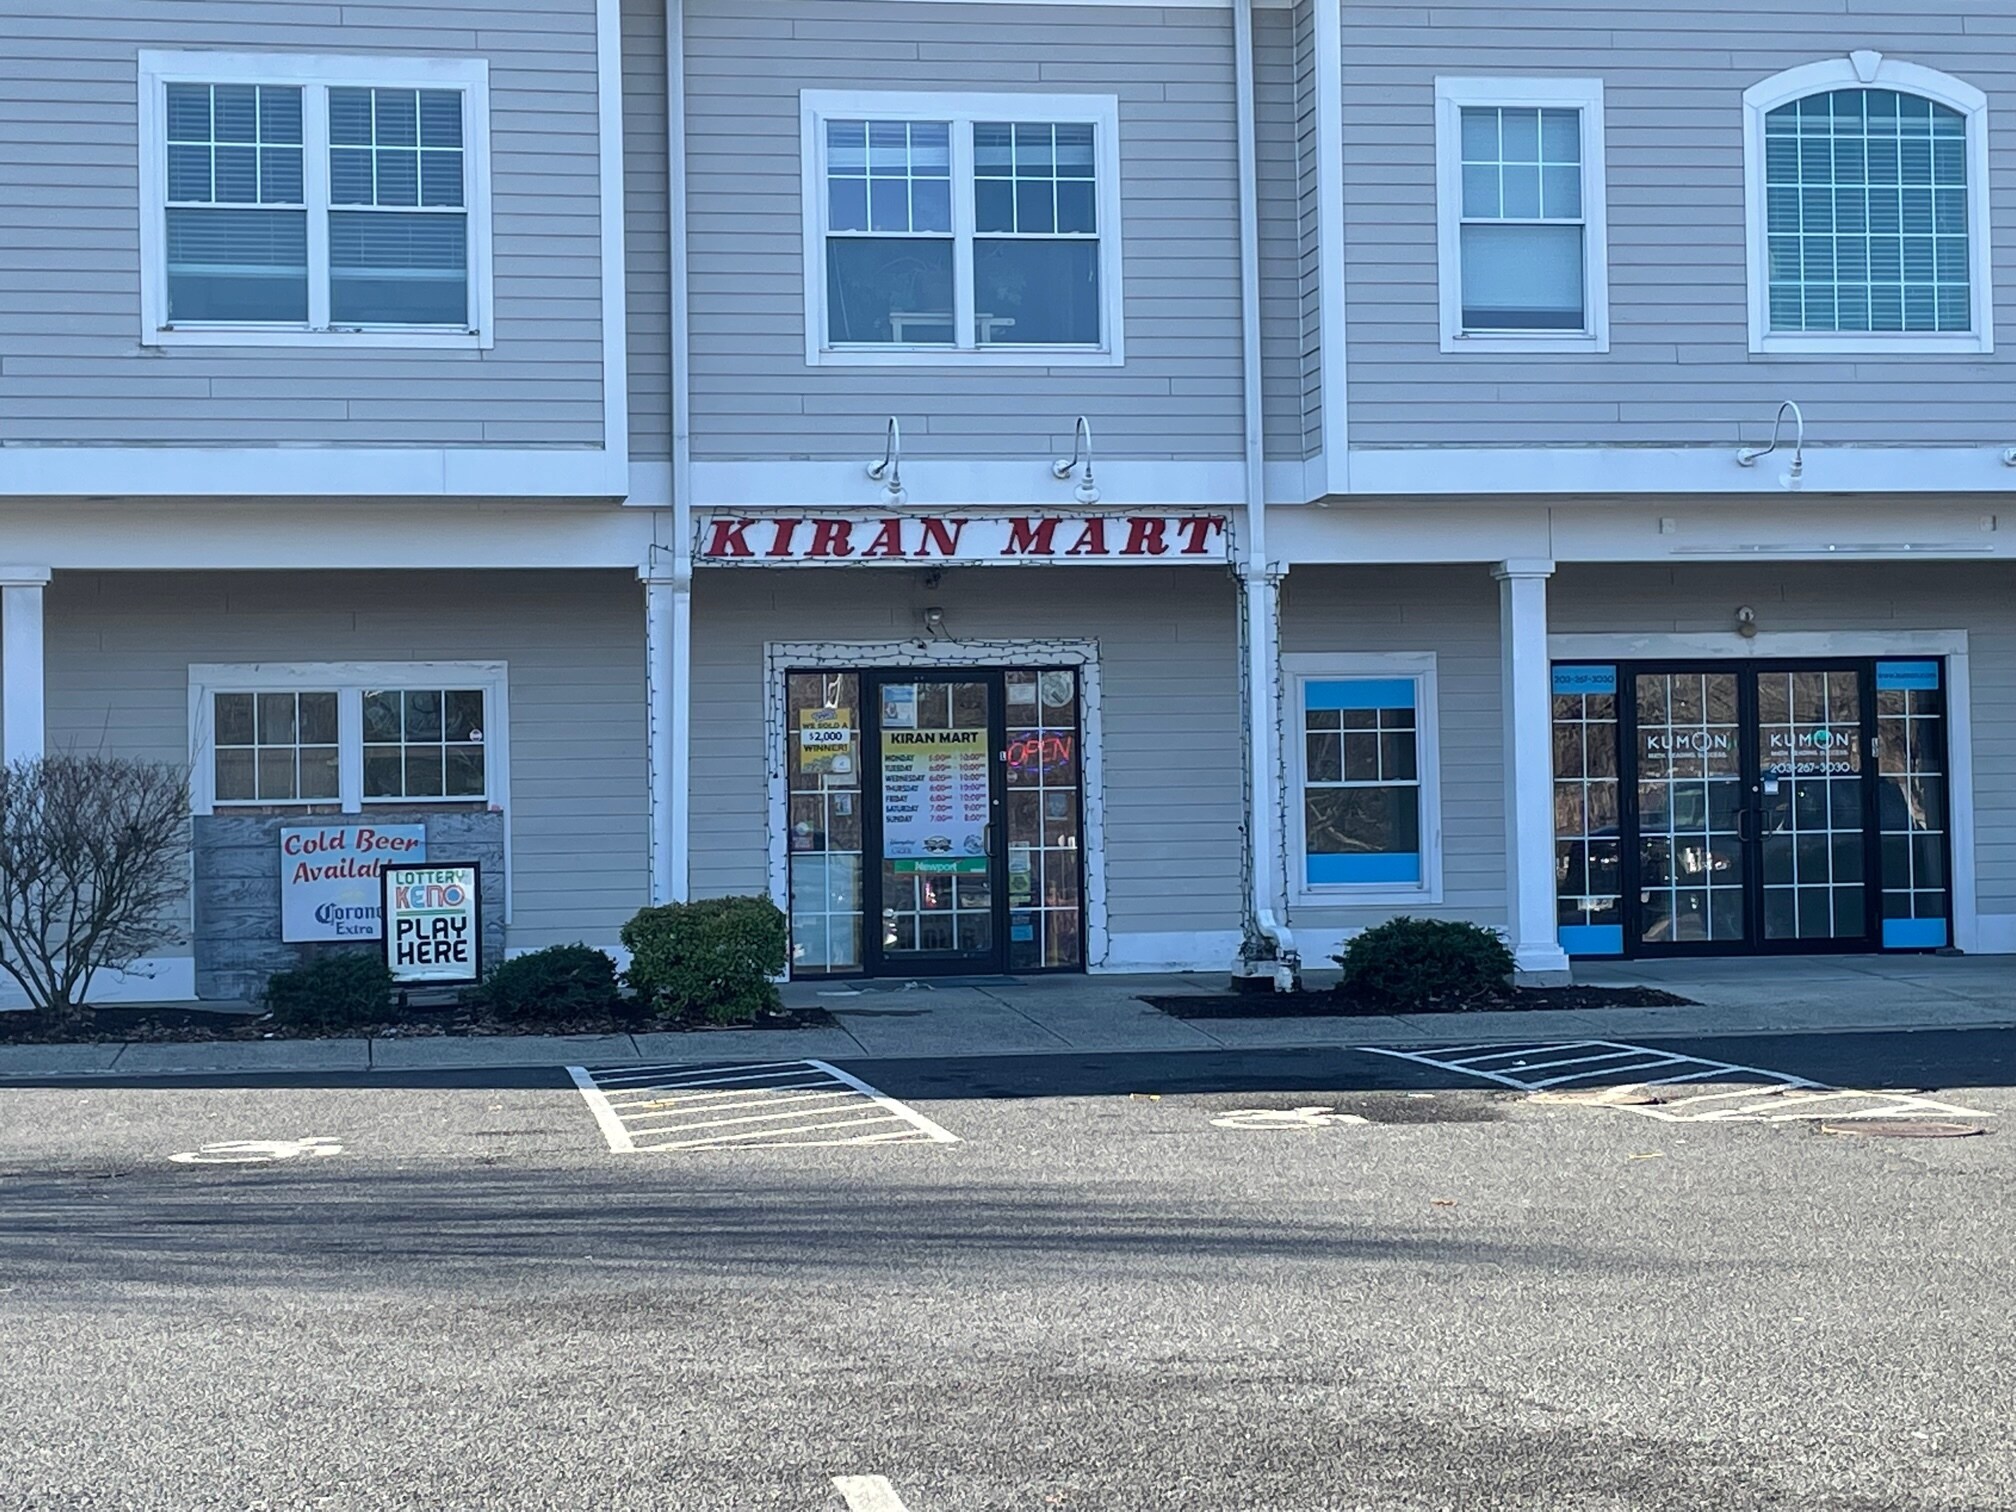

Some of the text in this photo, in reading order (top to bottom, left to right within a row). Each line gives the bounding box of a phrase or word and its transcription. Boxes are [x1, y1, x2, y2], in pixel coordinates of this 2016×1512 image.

[703, 517, 1225, 557] KIRAN MART
[842, 721, 848, 729] A
[809, 731, 842, 743] $2,000
[891, 731, 979, 744] KIRAN MART
[1648, 732, 1727, 751] KUMON
[1770, 730, 1849, 750] KUMON
[1007, 736, 1072, 765] OPEN
[1770, 762, 1850, 774] 203-267-3030
[284, 829, 419, 856] Cold Beer
[915, 861, 957, 873] Newport
[395, 870, 465, 885] LOTTERY
[395, 884, 465, 909] KENO
[336, 921, 374, 936] Extra
[397, 916, 467, 941] PLAY
[397, 940, 468, 965] HERE
